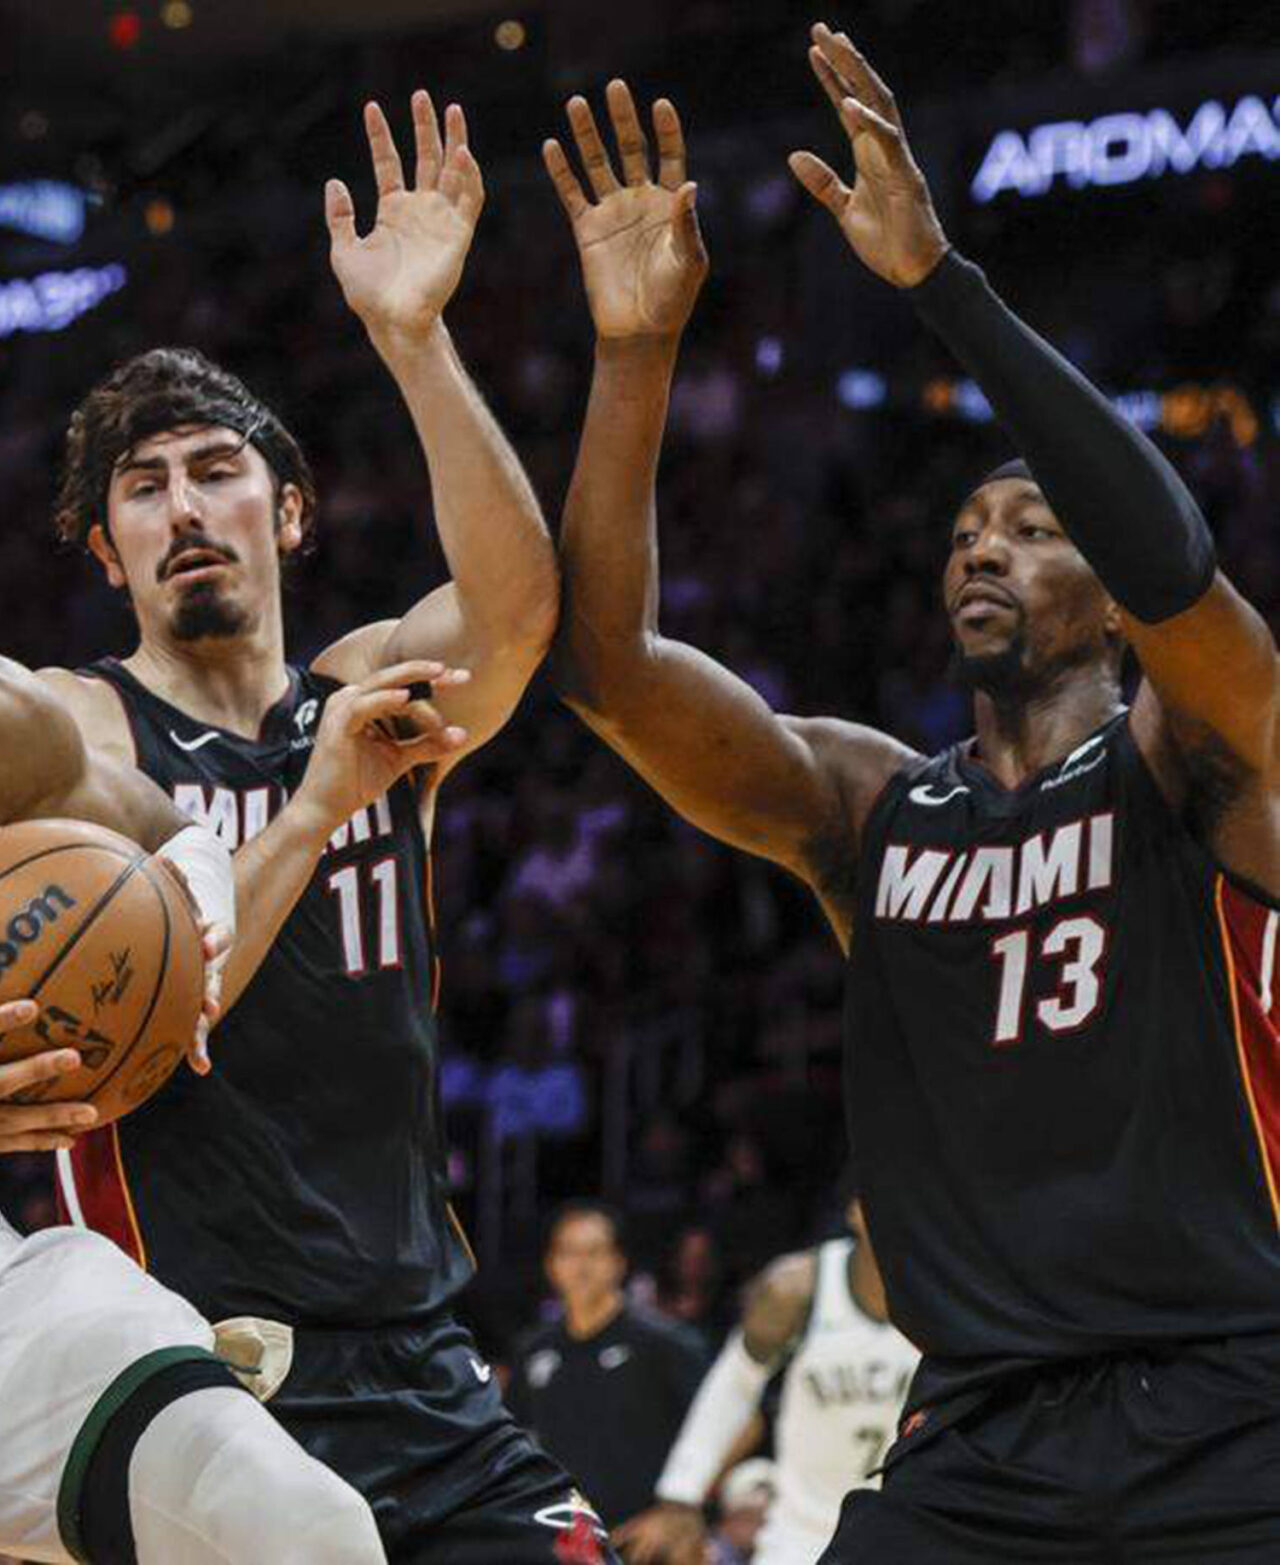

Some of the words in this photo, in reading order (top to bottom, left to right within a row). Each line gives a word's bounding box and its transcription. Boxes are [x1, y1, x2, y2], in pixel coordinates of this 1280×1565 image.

[971, 95, 1280, 204] AROMA
[328, 857, 401, 973] 11
[874, 812, 1114, 924] MIAMI
[992, 916, 1107, 1043] 13
